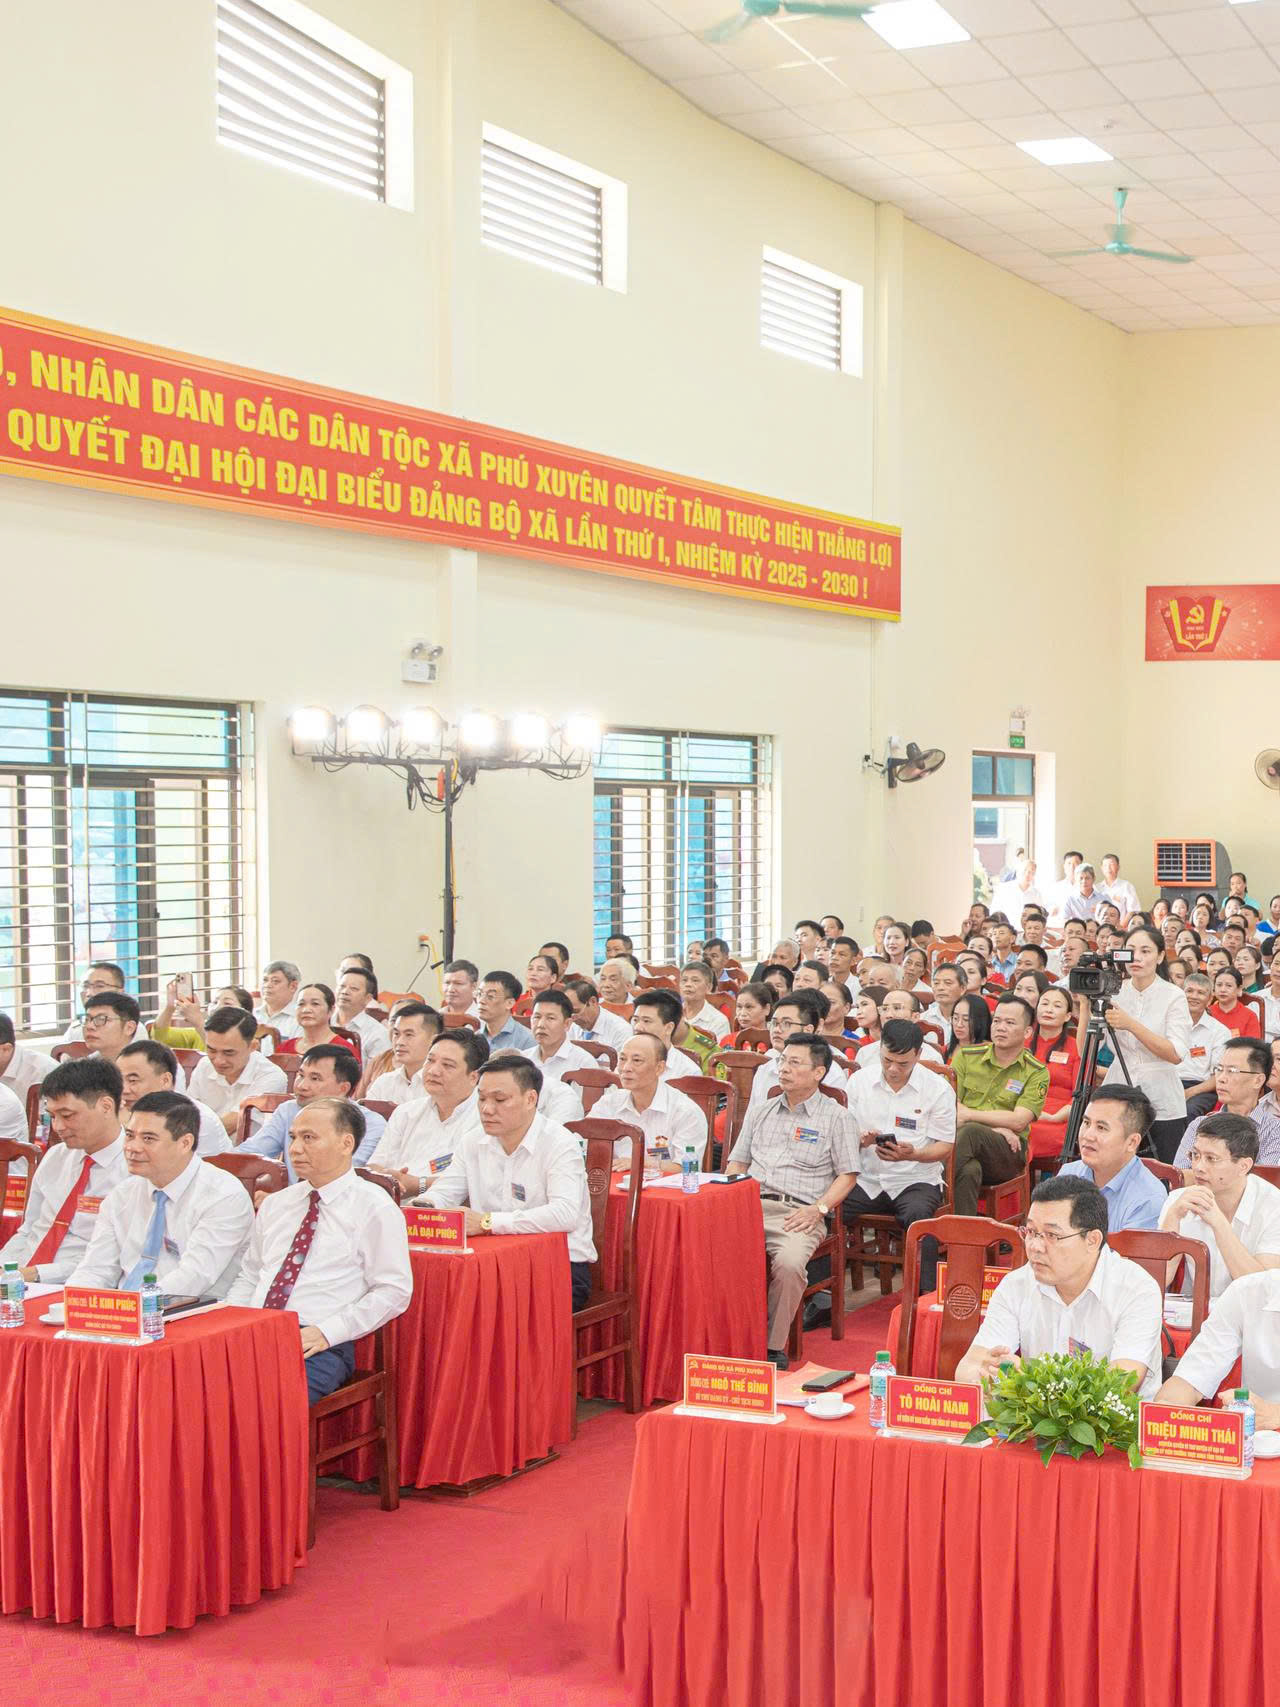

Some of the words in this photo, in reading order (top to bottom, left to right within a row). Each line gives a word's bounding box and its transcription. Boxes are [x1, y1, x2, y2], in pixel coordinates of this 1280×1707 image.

[30, 350, 140, 408] NHÂN
[152, 377, 224, 427] DÂN
[235, 396, 299, 441] CÁC
[309, 412, 370, 456] DÂN
[378, 426, 430, 471] TỘC
[438, 440, 473, 478] XÃ
[480, 453, 529, 489] PHÚ
[536, 464, 608, 507] XUYÊN
[615, 483, 677, 522] QUYẾT
[681, 497, 722, 532] TÂM
[726, 510, 771, 545] THỰC
[775, 520, 813, 554] HIỆN
[817, 527, 866, 562] THẮNG
[870, 541, 892, 570] LỢI
[7, 408, 130, 465] QUYẾT
[140, 434, 200, 483] ĐẠI
[211, 446, 266, 494] HỘI
[275, 461, 327, 507] ĐẠI
[337, 466, 401, 514] BIỂU
[409, 480, 482, 528] ĐẢNG
[489, 499, 522, 541] BỘ
[528, 507, 560, 543] XÃ
[565, 511, 608, 552] LẦN
[613, 524, 655, 560] THỨ
[658, 536, 671, 567] I,
[676, 540, 737, 578] NHIỆM
[741, 551, 764, 581] KỲ
[768, 559, 807, 589] 2025
[822, 569, 859, 599] 2030
[939, 1386, 952, 1395] CHÍ
[899, 1393, 912, 1408] TÔ
[915, 1395, 940, 1412] HOÀI
[943, 1400, 968, 1415] NAM
[1197, 1414, 1212, 1423] CHÍ
[1146, 1421, 1177, 1440] TRIỆU
[1180, 1425, 1208, 1442] MINH
[1211, 1428, 1236, 1445] THÁI
